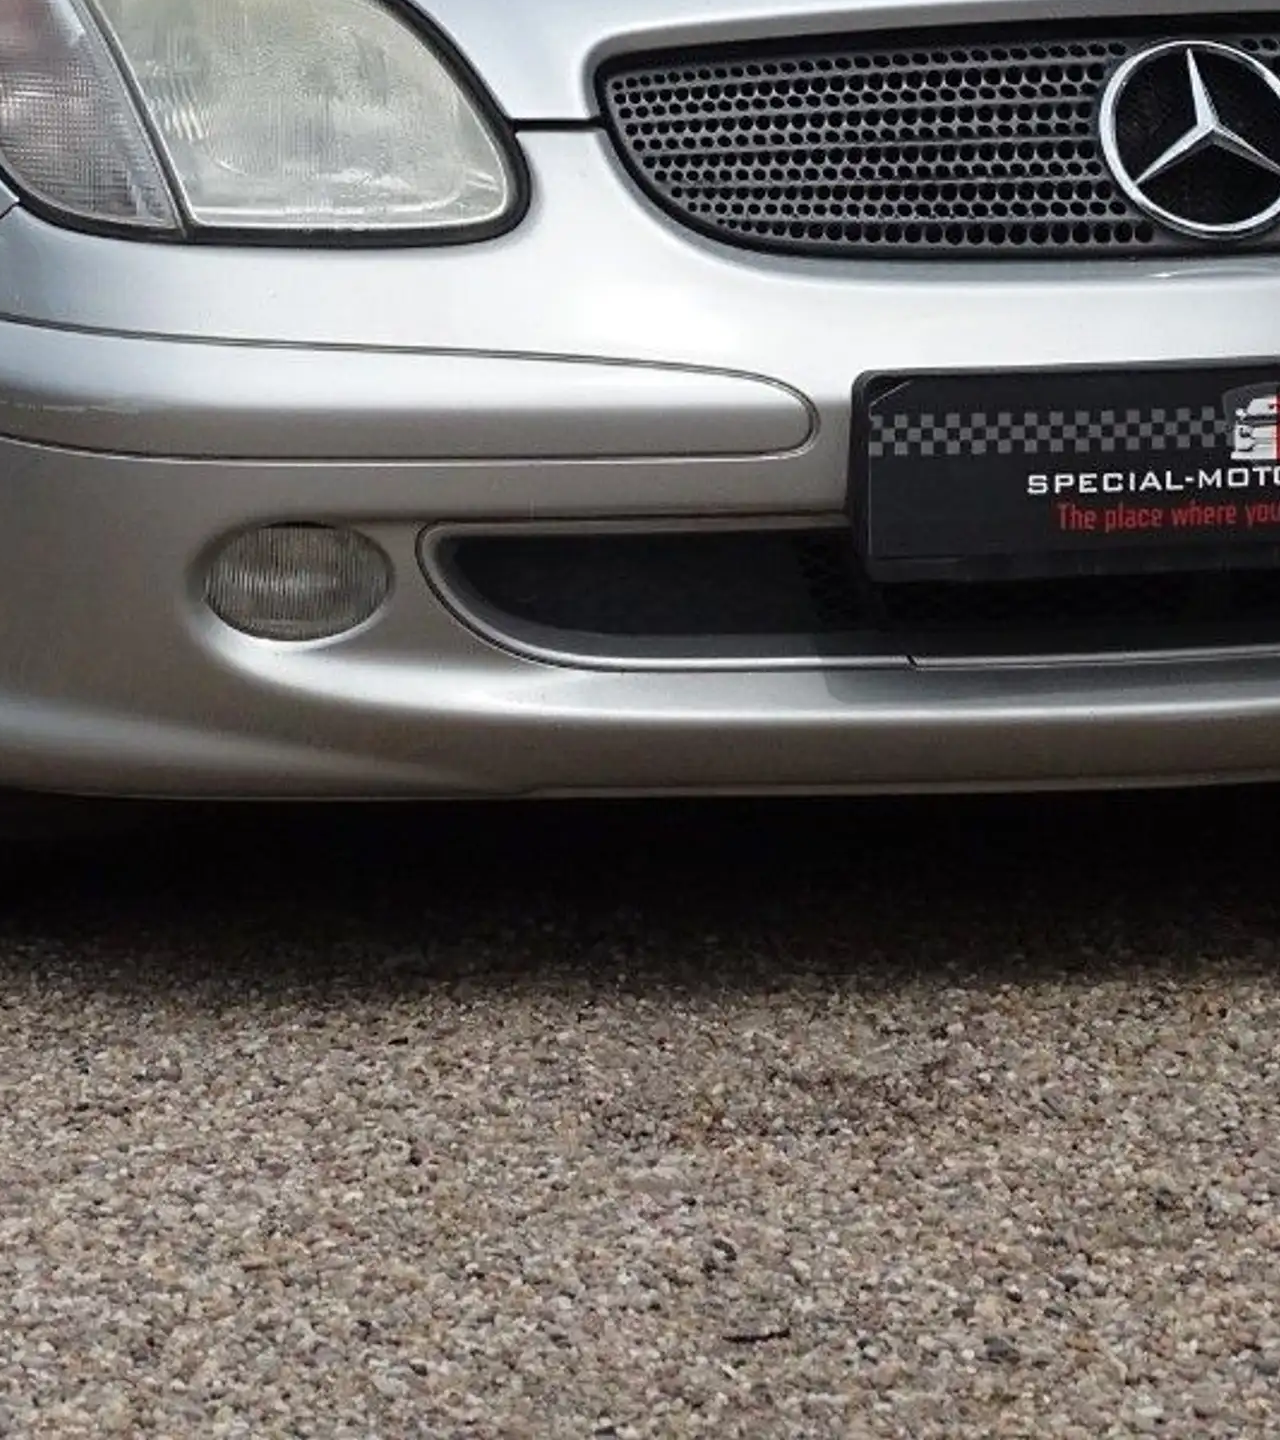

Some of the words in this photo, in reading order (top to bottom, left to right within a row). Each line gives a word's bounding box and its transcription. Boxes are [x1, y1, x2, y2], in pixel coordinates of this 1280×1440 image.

[1057, 502, 1095, 531] The
[1105, 502, 1162, 533] place
[1170, 500, 1237, 527] where
